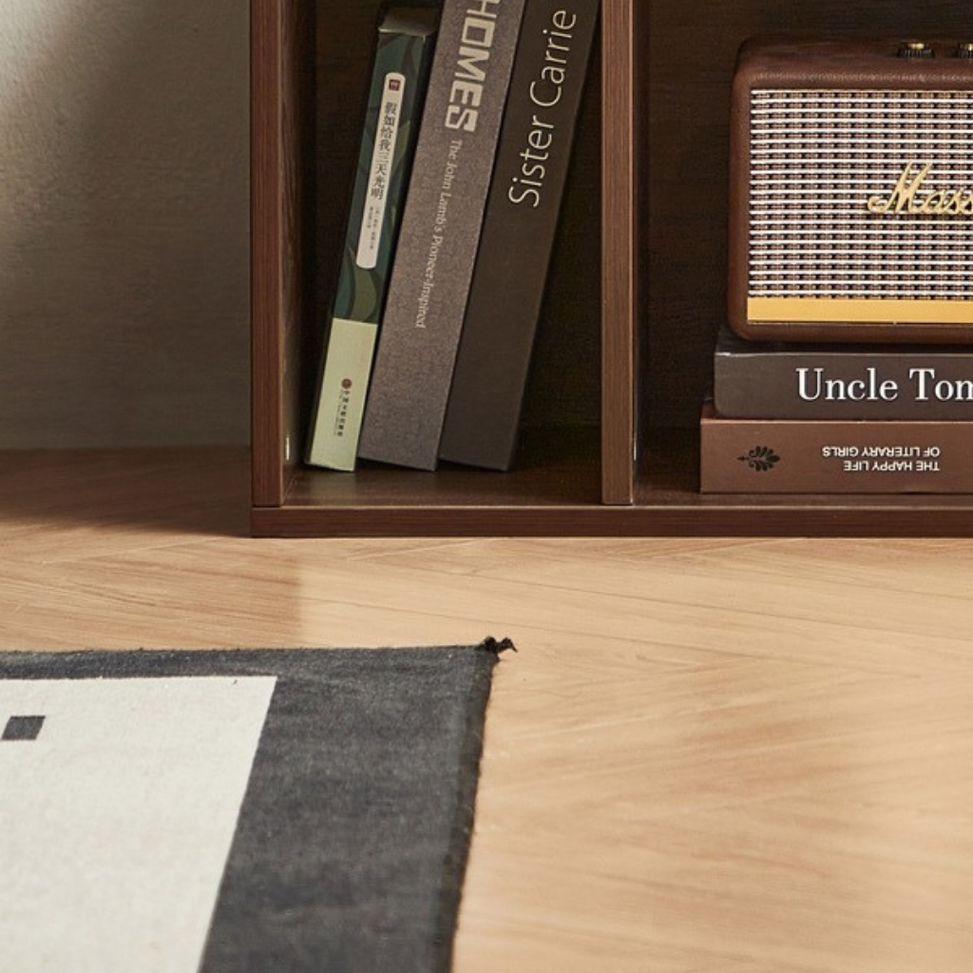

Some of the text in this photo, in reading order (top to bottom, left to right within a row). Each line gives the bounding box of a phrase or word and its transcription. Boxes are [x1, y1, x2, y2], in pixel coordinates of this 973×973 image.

[508, 10, 577, 207] Sister Carrie
[370, 101, 398, 201] 假如给我三天光明
[450, 138, 463, 160] The
[442, 160, 459, 190] John
[796, 367, 899, 402] Uncle
[821, 446, 941, 458] OF LITERARY GIRLS
[843, 460, 941, 472] THE HAPPY LIFE
